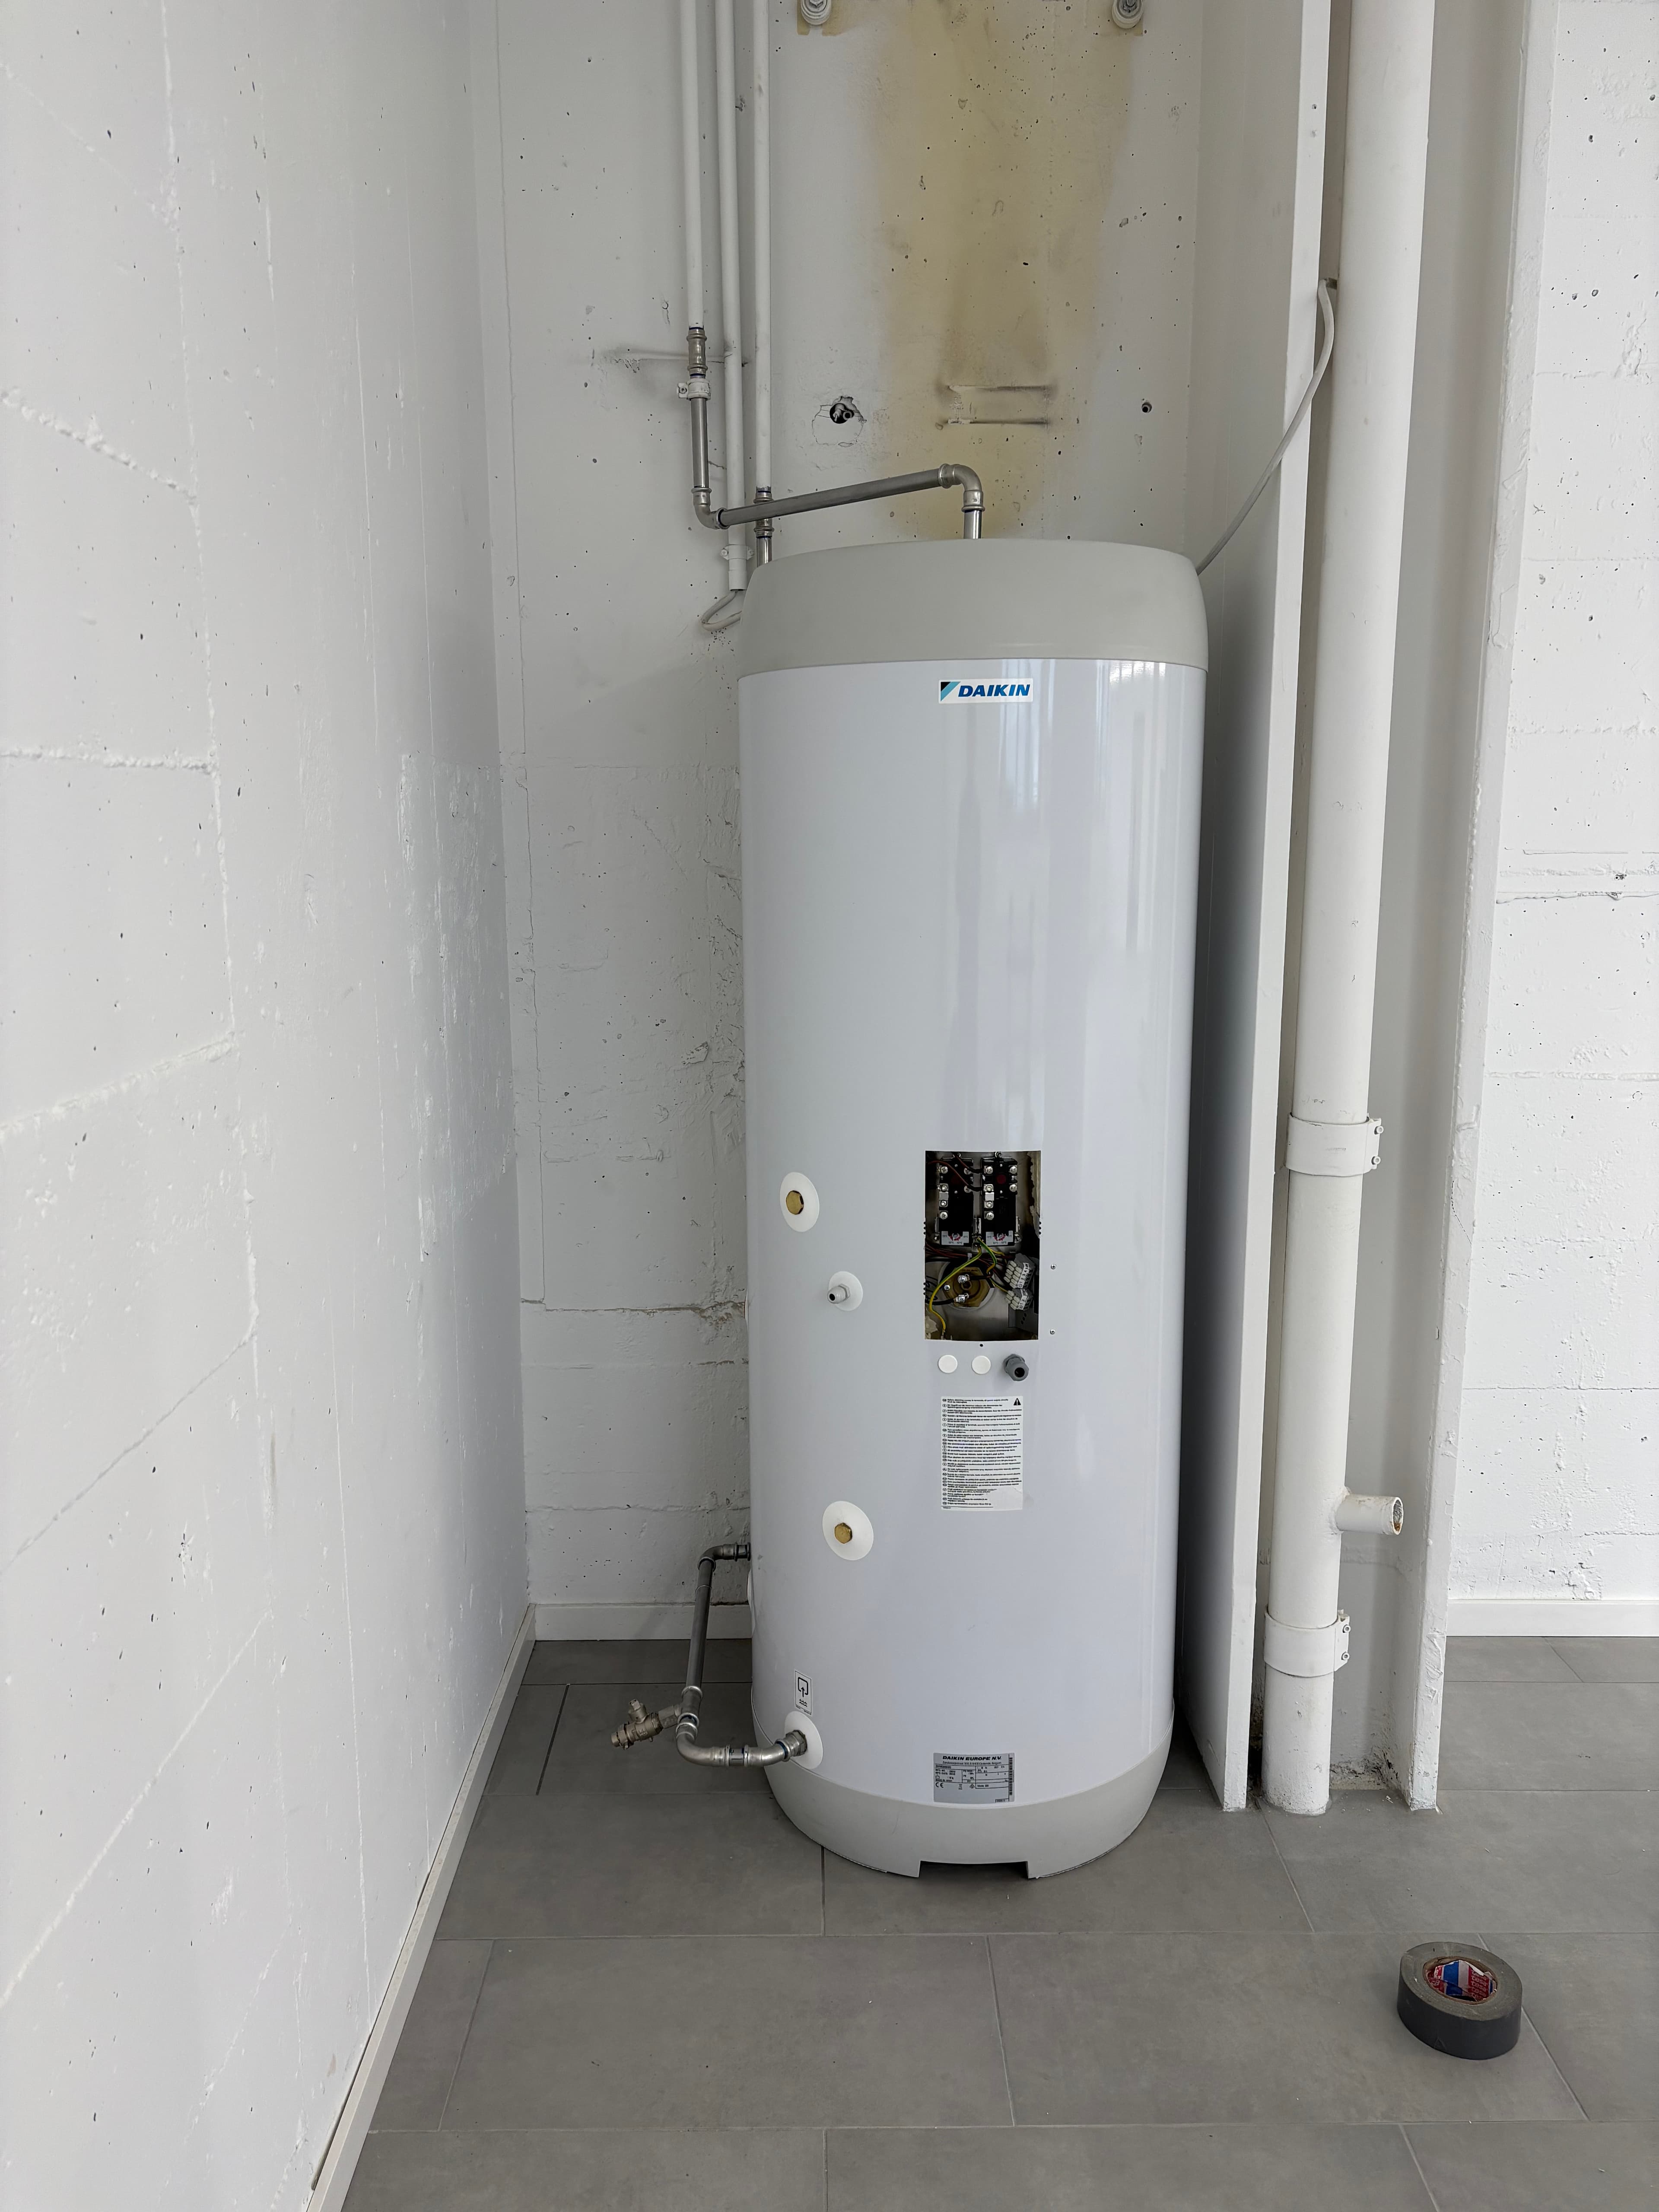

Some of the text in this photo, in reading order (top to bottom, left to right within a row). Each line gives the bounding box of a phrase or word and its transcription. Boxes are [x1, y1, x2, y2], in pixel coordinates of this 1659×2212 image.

[958, 684, 1030, 697] DAIKIN
[1471, 1975, 1487, 1986] tesa
[1471, 1981, 1486, 1992] tesa
